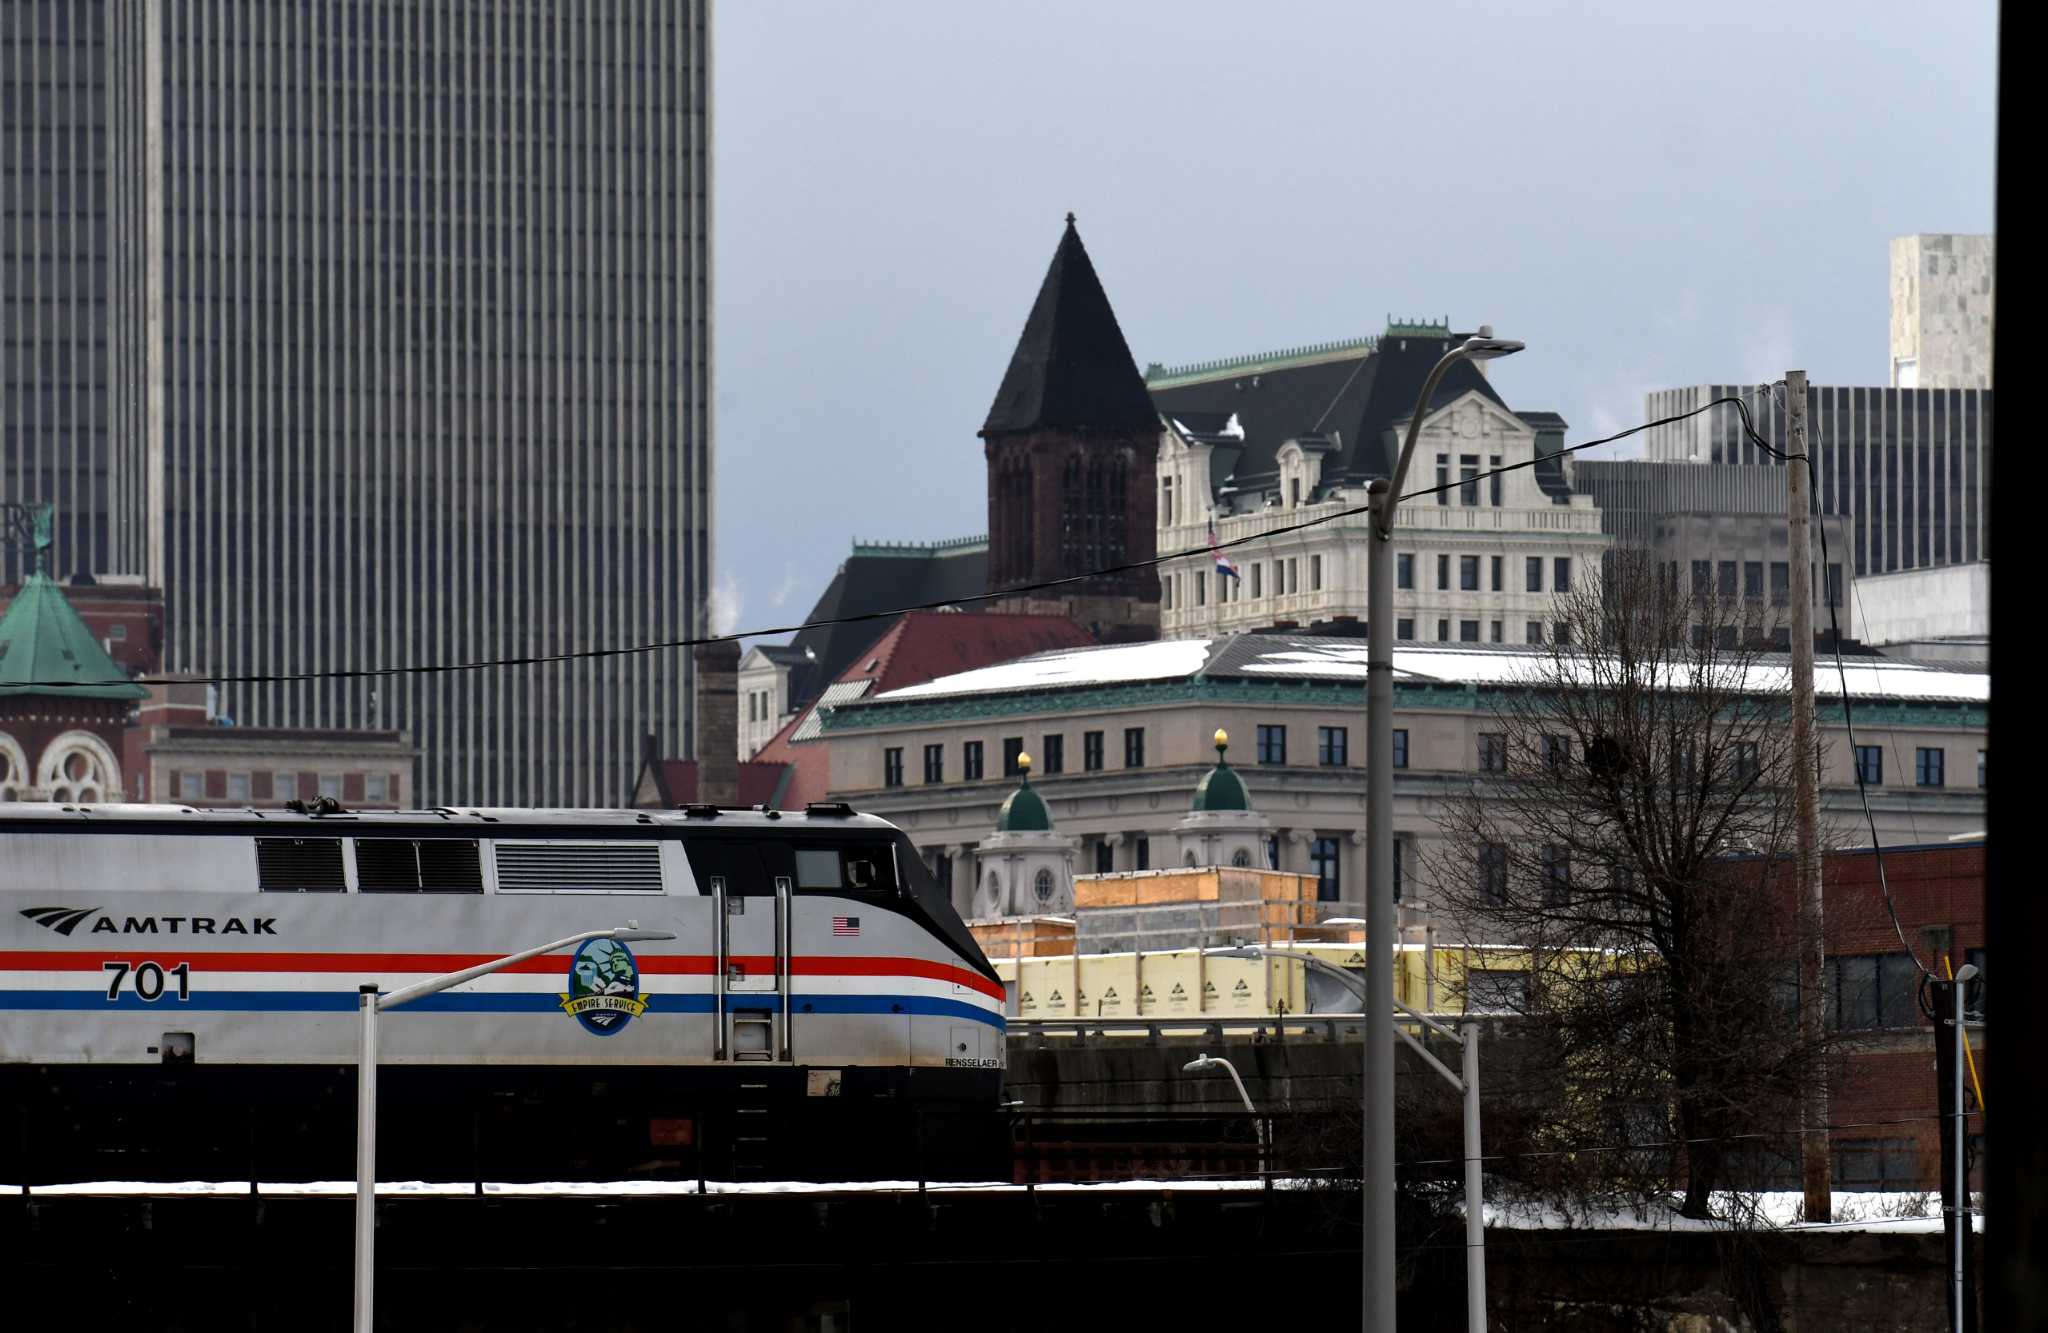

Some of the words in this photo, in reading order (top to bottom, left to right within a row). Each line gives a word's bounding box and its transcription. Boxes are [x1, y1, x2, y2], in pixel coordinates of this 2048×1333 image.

[91, 916, 278, 935] AMTRAK
[103, 961, 190, 1001] 701
[572, 998, 600, 1013] EMPIRE
[604, 998, 635, 1012] SERVICE
[945, 1057, 998, 1068] RENSSELAER
